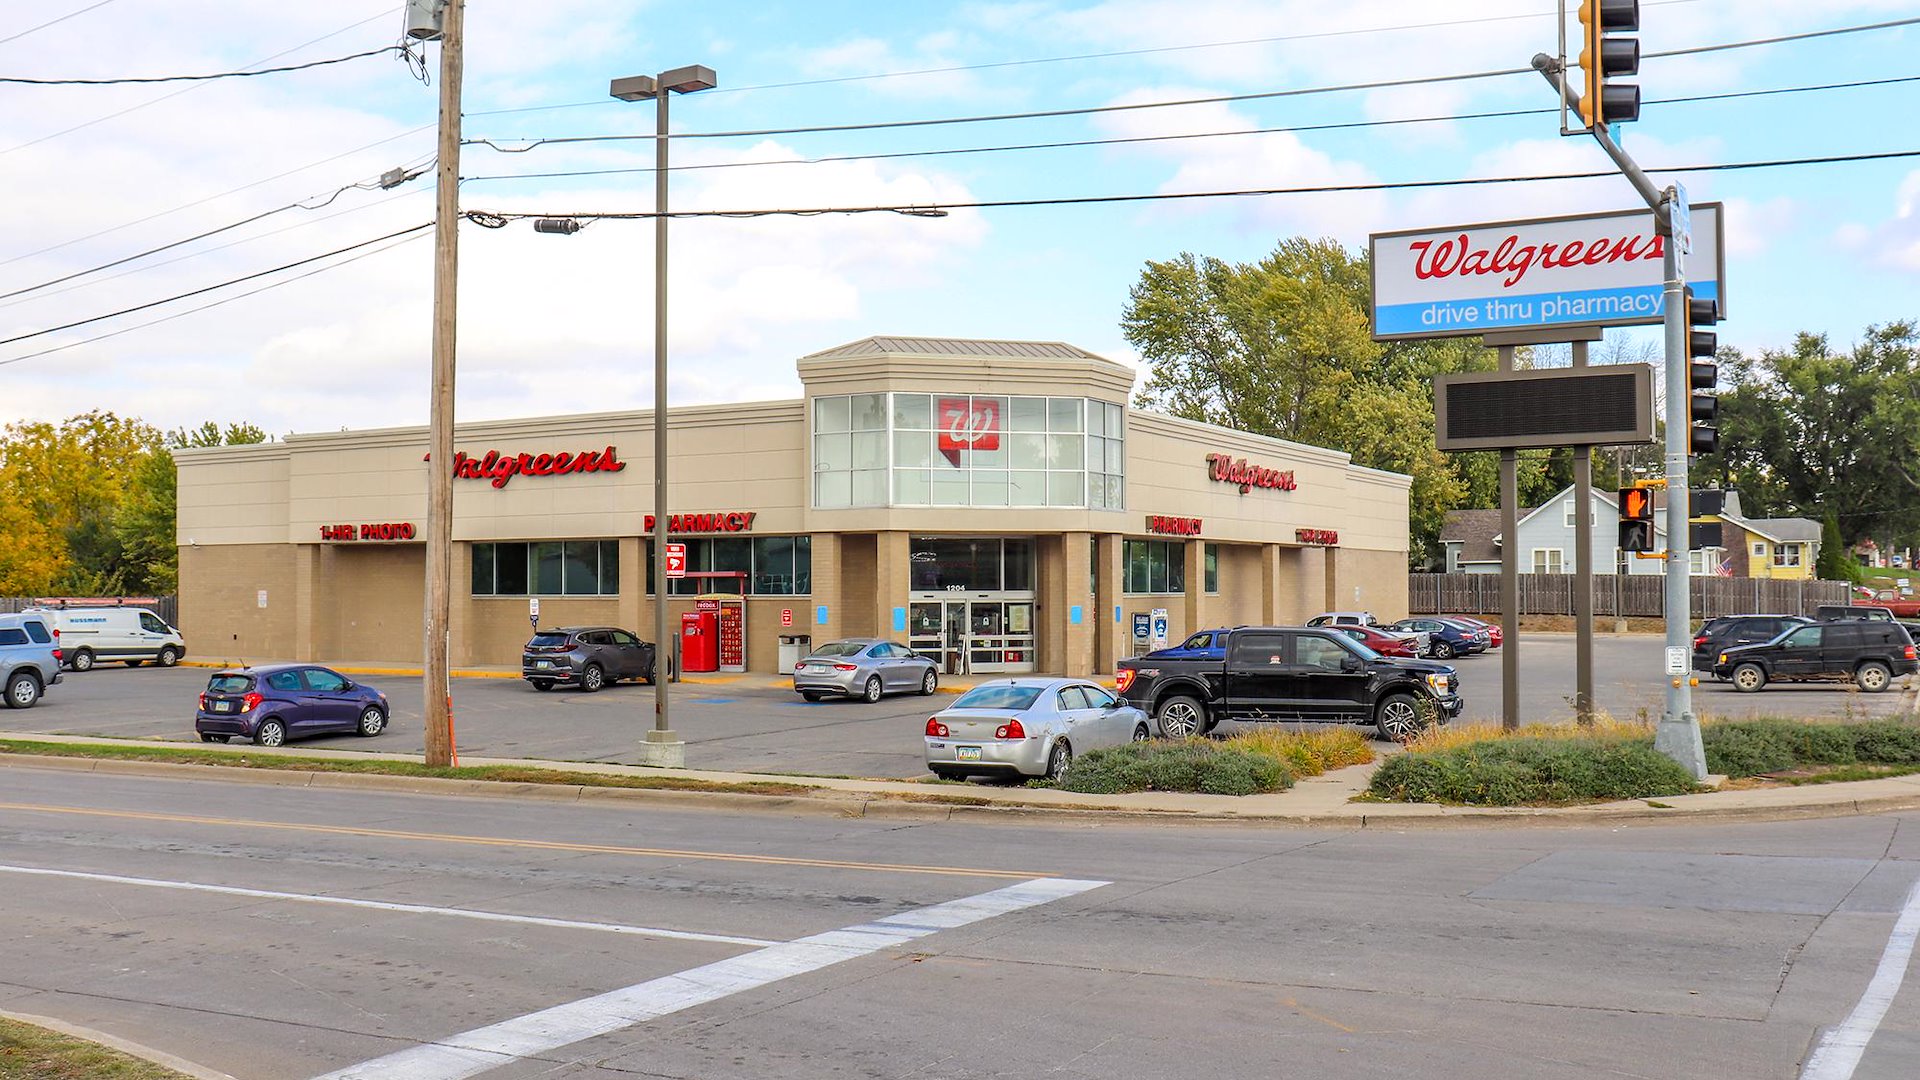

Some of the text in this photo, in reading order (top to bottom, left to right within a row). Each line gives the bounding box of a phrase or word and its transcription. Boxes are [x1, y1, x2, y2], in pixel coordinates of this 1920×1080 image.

[1409, 233, 1665, 288] Walgreens
[1421, 293, 1665, 326] drive thru pharmacy
[1207, 453, 1297, 494] Walgreens
[320, 522, 414, 540] 1-HR PHOTO
[644, 512, 755, 533] PARMACY
[1150, 515, 1202, 535] PHARMACY
